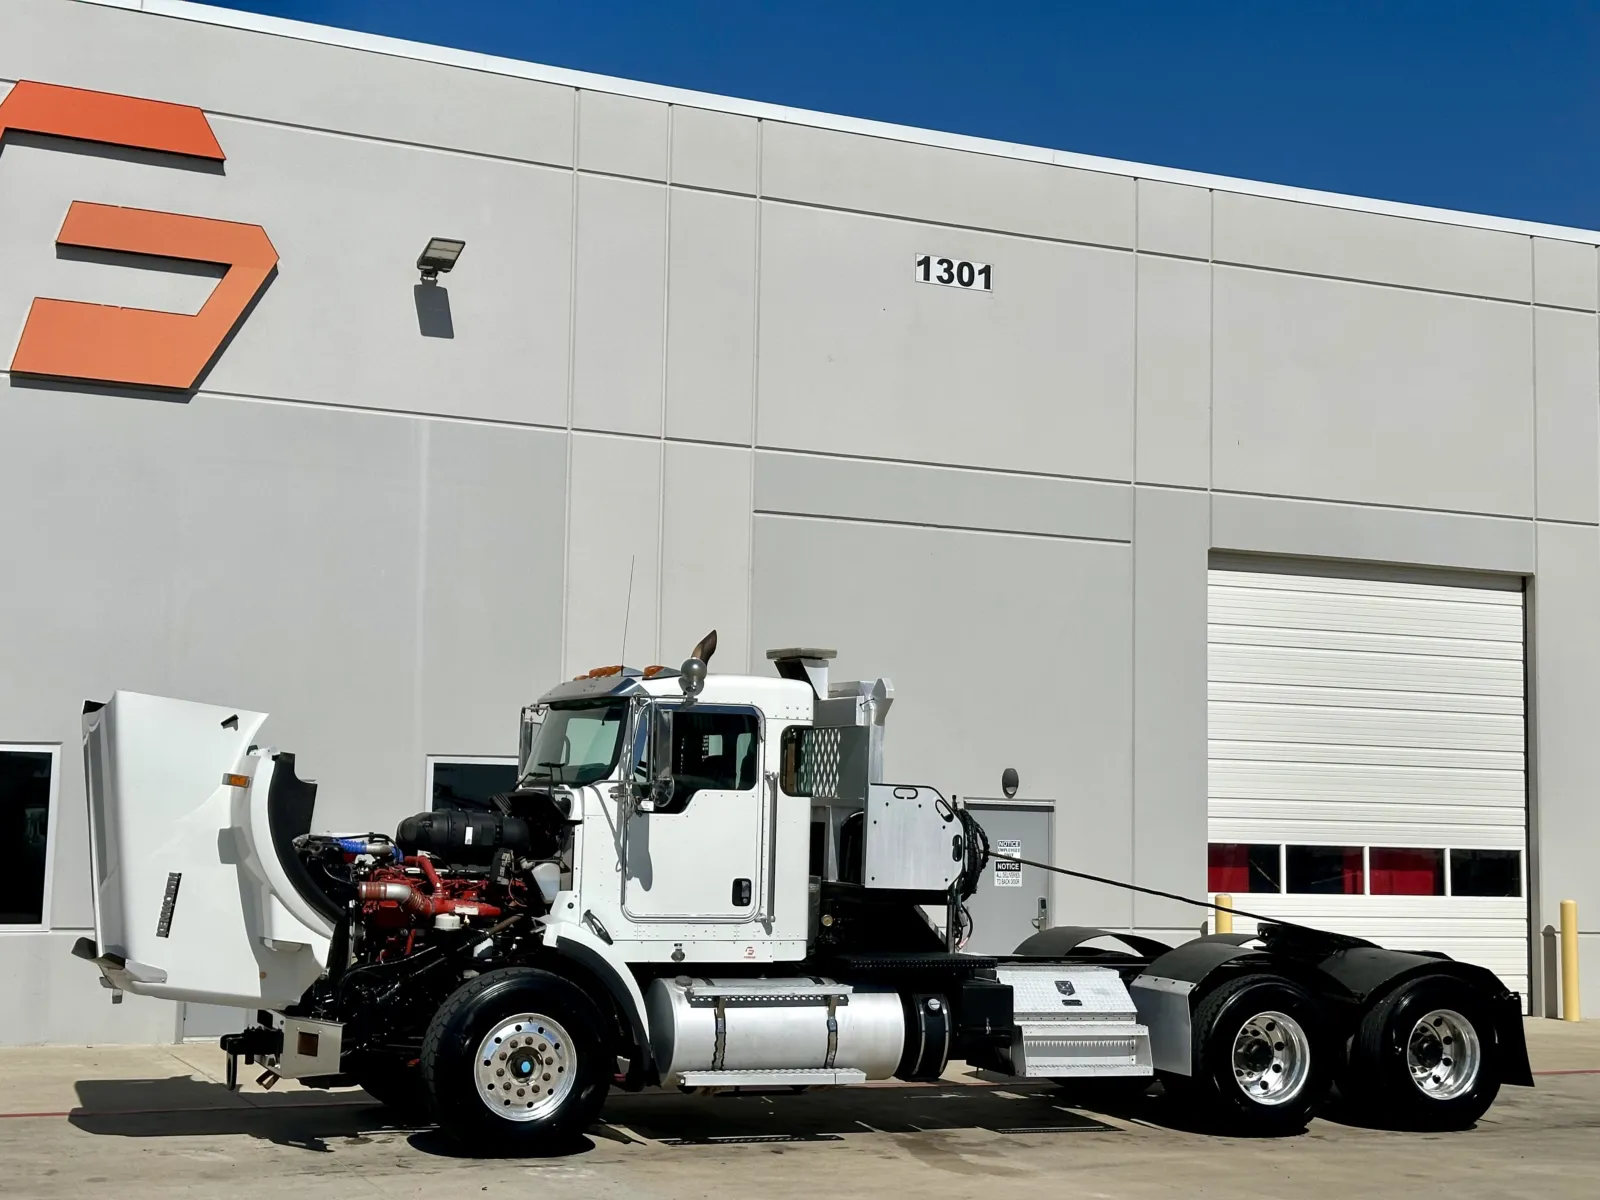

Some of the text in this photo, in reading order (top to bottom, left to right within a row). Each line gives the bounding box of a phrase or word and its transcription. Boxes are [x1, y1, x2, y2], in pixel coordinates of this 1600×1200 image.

[917, 255, 991, 290] 1301
[997, 862, 1020, 870] NOTICE
[156, 872, 181, 937] KENWORTH
